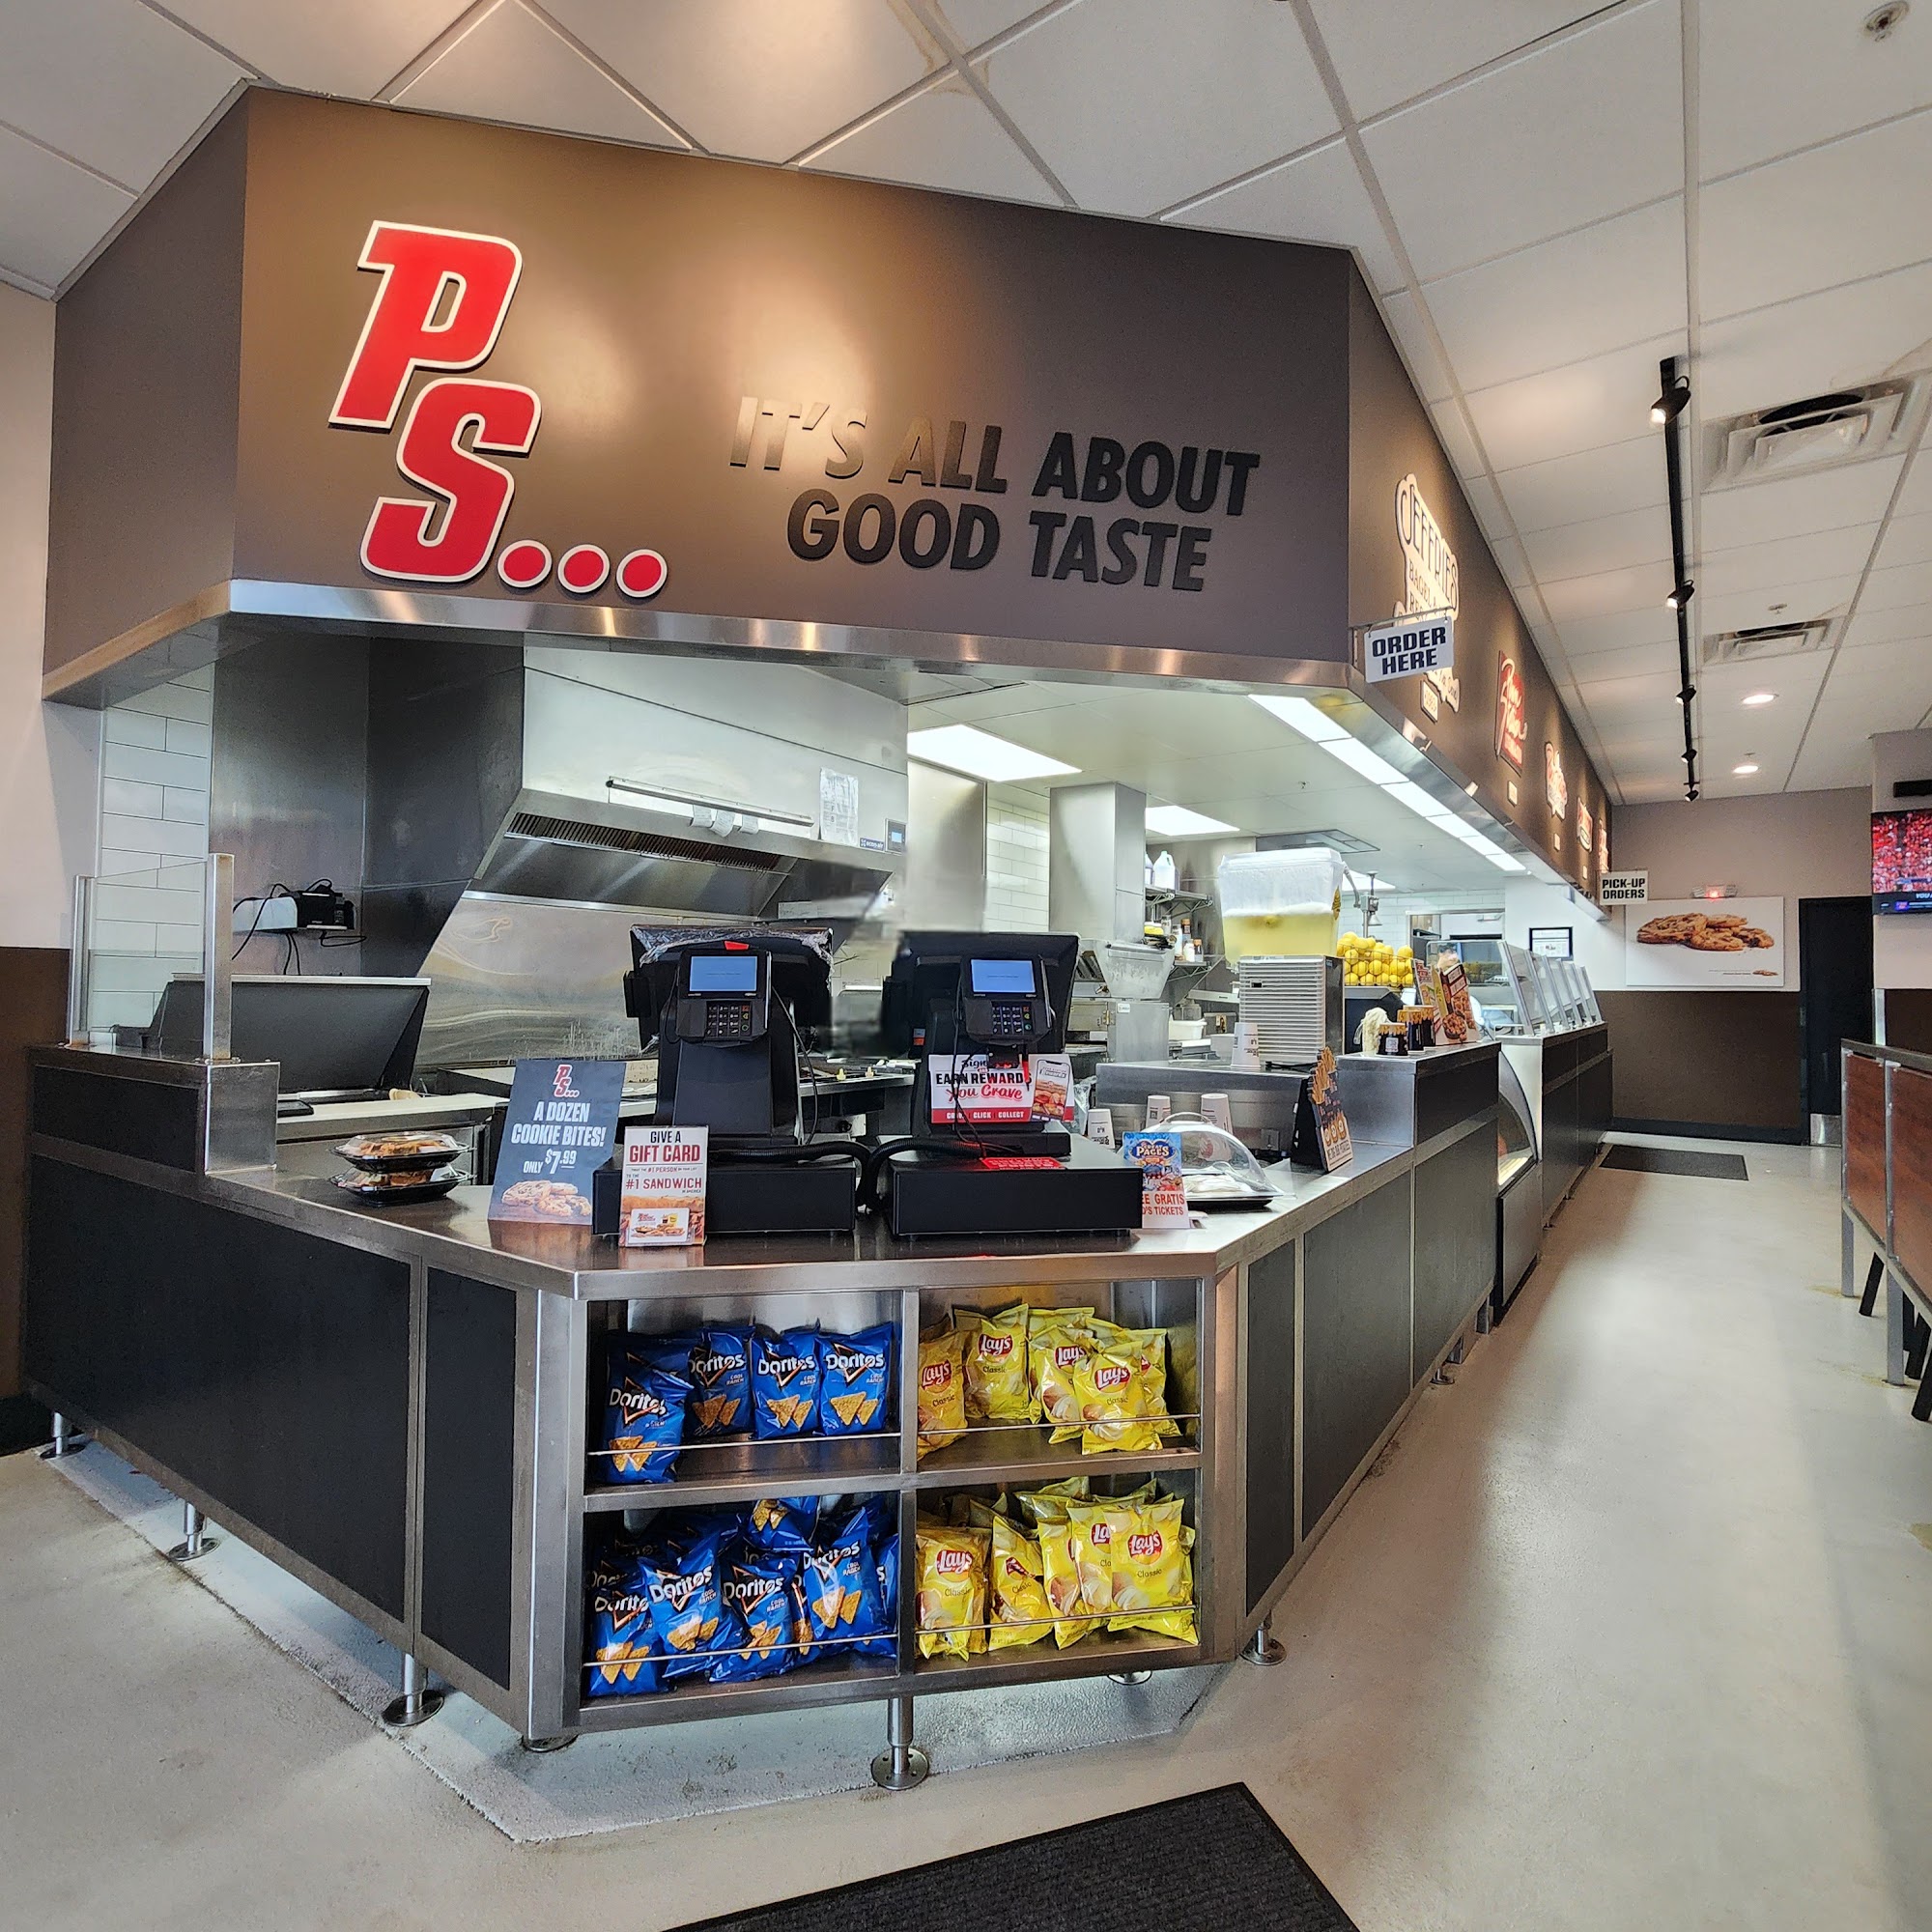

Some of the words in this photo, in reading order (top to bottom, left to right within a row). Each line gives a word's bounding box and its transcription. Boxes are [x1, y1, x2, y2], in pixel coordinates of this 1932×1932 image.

[730, 397, 867, 479] IT'S
[888, 415, 1008, 494] ALL
[1031, 432, 1261, 516] ABOUT
[787, 489, 1001, 571] GOOD
[1029, 510, 1212, 591] TASTE
[1400, 483, 1458, 611] JEFFRIES
[1372, 627, 1446, 657] ORDER
[1382, 648, 1437, 675] HERE
[1602, 878, 1645, 889] PICK-UP
[1603, 889, 1645, 899] ORDERS
[946, 1087, 978, 1101] You
[980, 1084, 1023, 1099] Crave
[533, 1101, 545, 1122] A
[546, 1101, 590, 1122] DOZEN
[511, 1123, 561, 1146] COOKIE
[561, 1125, 607, 1147] BITES!
[650, 1130, 672, 1144] GIVE
[674, 1130, 682, 1144] A
[629, 1145, 659, 1162] GIFT
[663, 1145, 700, 1162] CARD
[1136, 1146, 1169, 1157] PAGES
[523, 1160, 543, 1174] ONLY
[545, 1148, 578, 1175] $7.99
[625, 1179, 639, 1190] #1
[642, 1177, 702, 1190] SANDWICH
[1154, 1193, 1185, 1205] GRATIS
[1154, 1206, 1184, 1215] TICKETS
[690, 1353, 746, 1375] Doritos
[757, 1355, 815, 1375] Doritos
[825, 1353, 884, 1370] Doritos
[982, 1365, 1007, 1374] Classic
[609, 1388, 667, 1415] Doritos
[932, 1394, 955, 1406] Classic
[1106, 1396, 1128, 1406] Classic
[1137, 1568, 1162, 1578] Classic
[649, 1565, 713, 1604] Doritos
[723, 1577, 784, 1600] Doritos
[944, 1587, 971, 1598] Classic
[594, 1594, 649, 1612] Dorito
